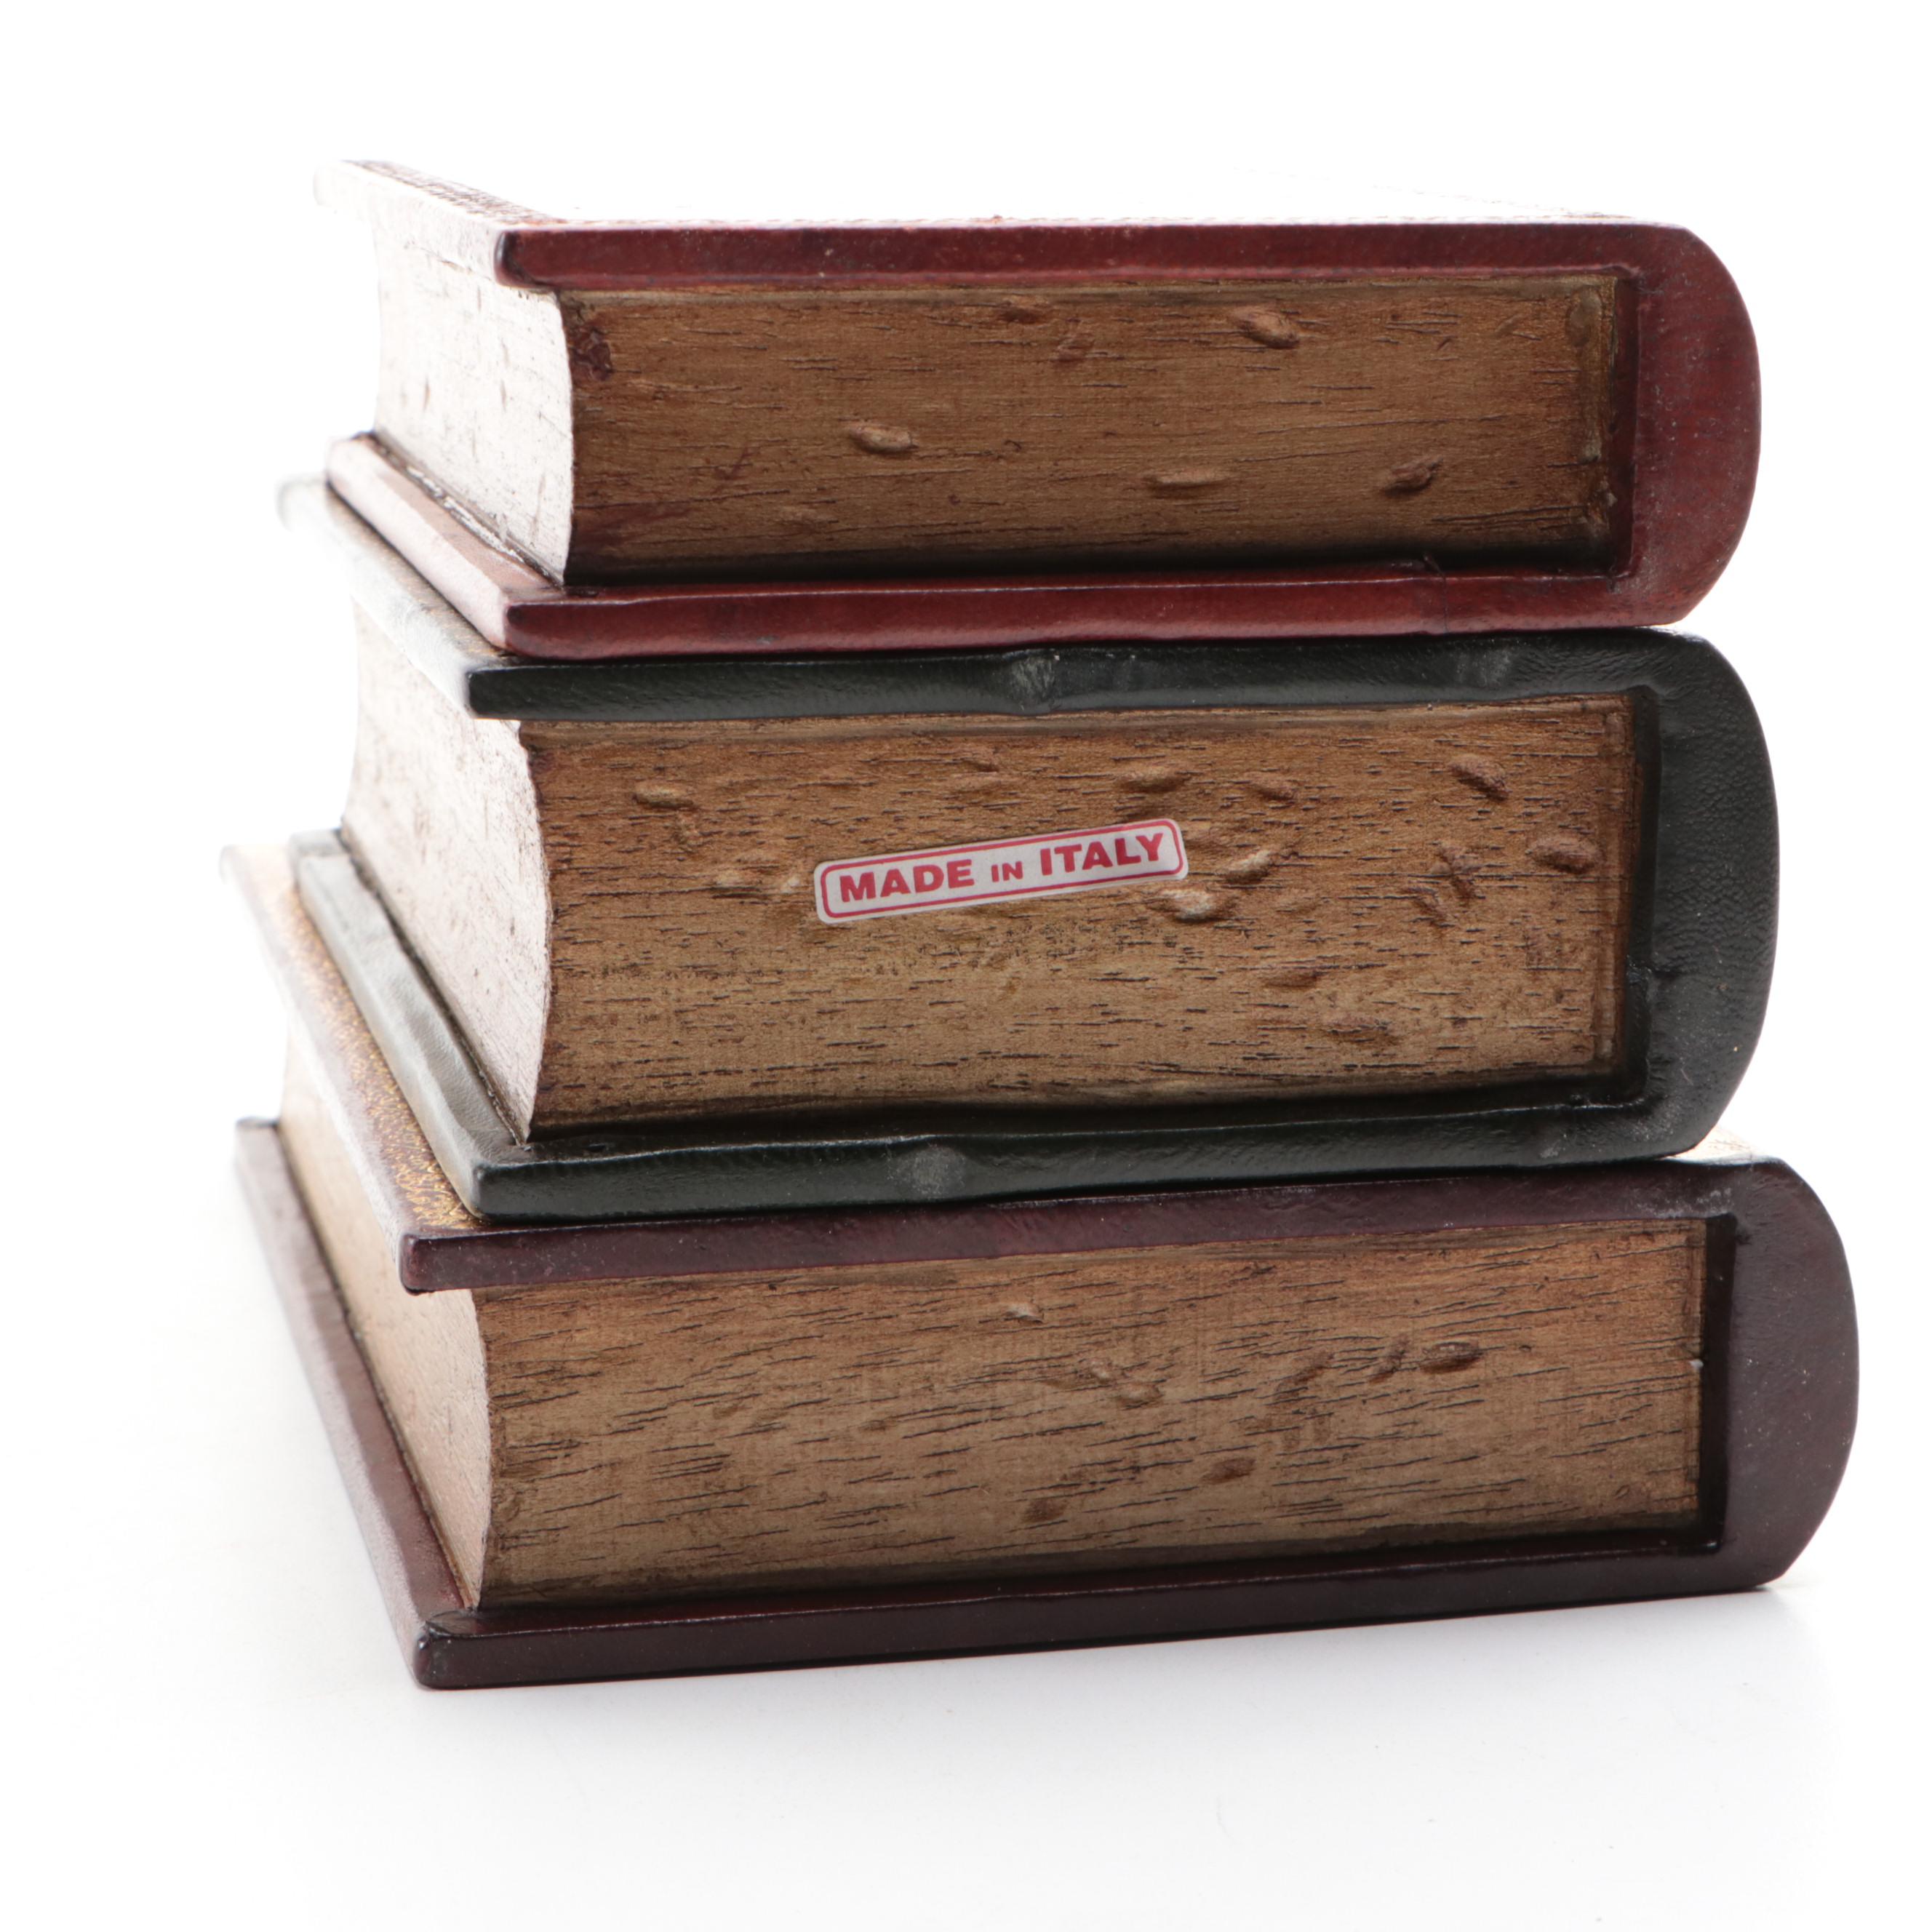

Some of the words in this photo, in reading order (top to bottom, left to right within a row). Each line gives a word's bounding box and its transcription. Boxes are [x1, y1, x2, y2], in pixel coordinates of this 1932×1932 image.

[839, 859, 975, 903] MADE
[991, 861, 1023, 882] IN
[1040, 832, 1164, 876] ITALY
